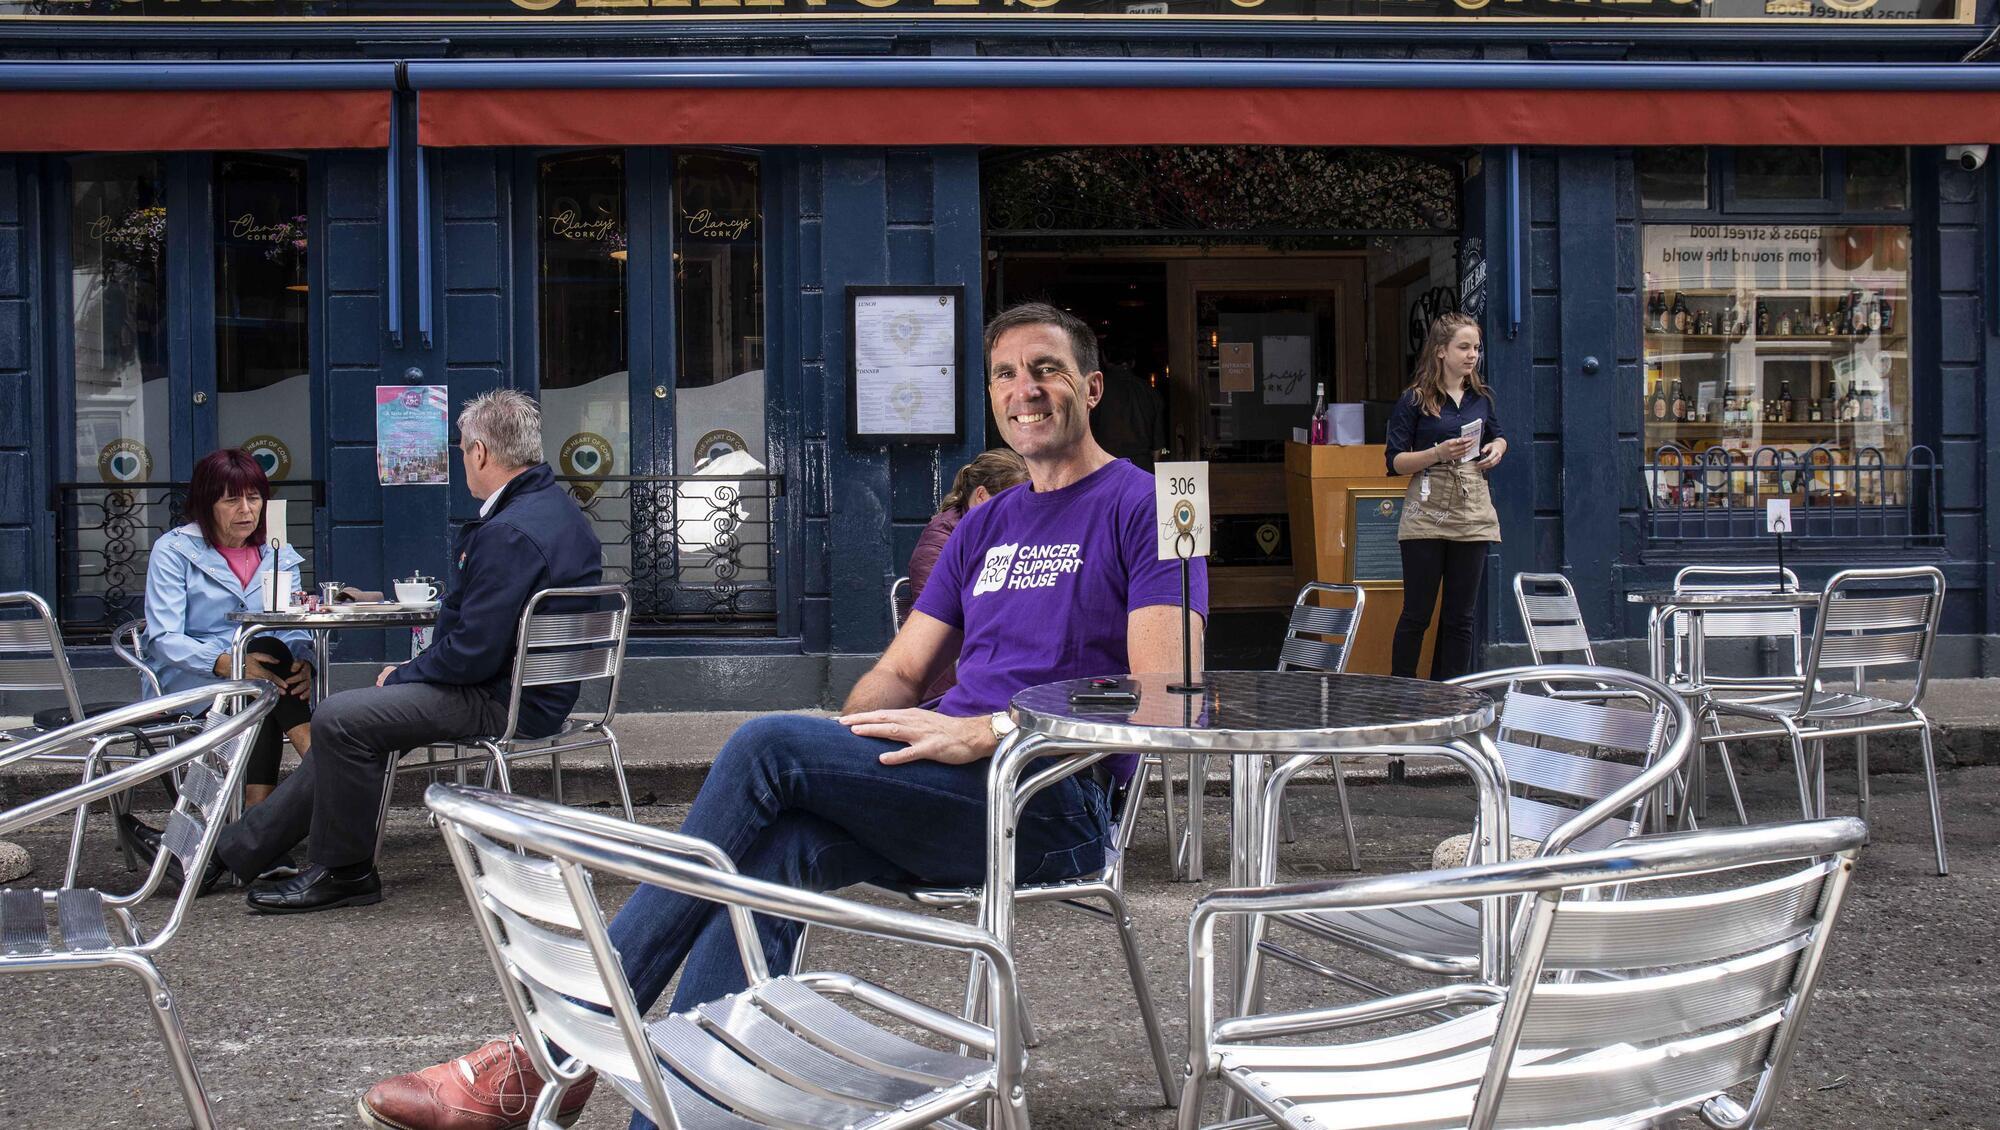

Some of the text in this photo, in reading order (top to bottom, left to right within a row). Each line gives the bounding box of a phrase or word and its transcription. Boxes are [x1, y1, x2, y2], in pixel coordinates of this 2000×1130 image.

[1169, 476, 1196, 496] 306
[1018, 543, 1080, 560] CANCER
[1012, 558, 1084, 575] SUPPORT
[1007, 572, 1059, 590] HOUSE
